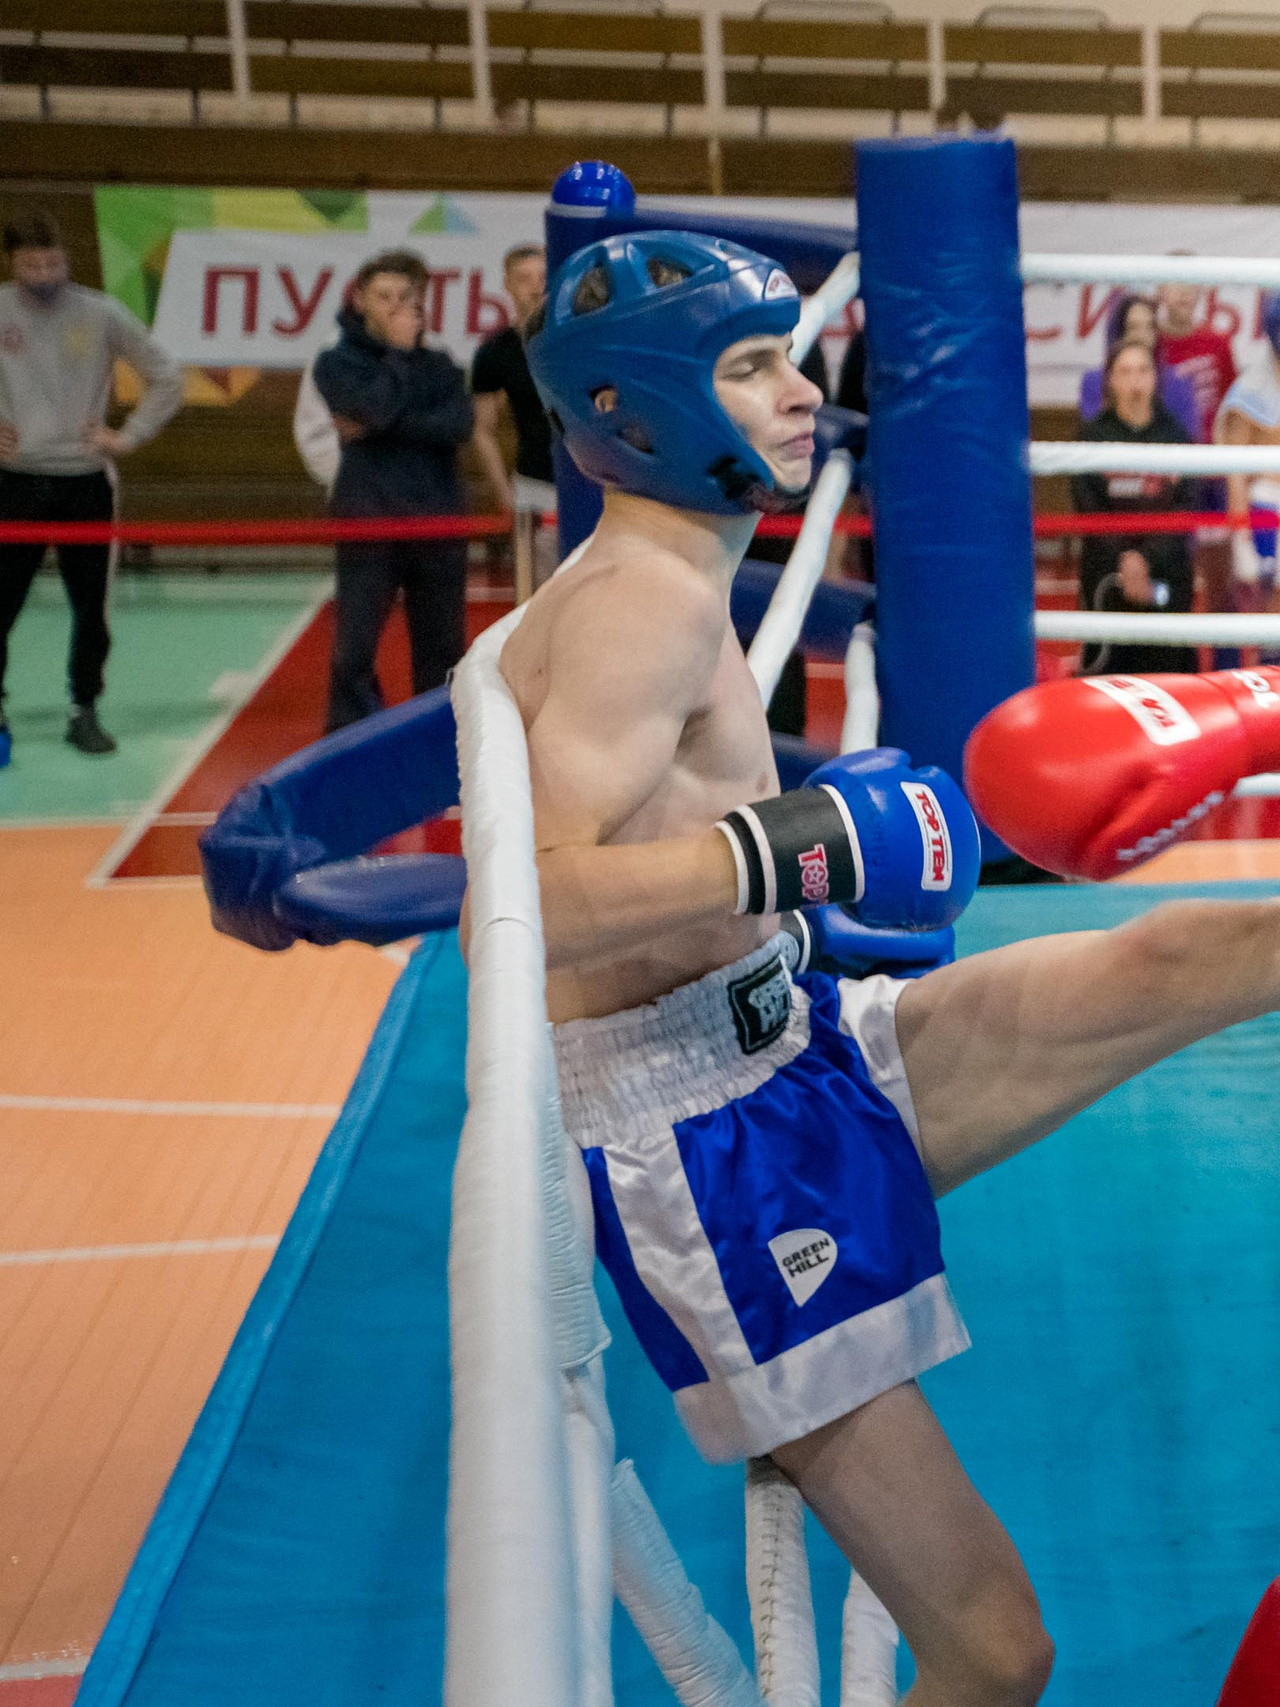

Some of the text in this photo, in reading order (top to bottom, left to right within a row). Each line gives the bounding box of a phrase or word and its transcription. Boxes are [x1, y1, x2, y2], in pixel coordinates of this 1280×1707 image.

[202, 264, 515, 338] ПУТЬ
[915, 792, 941, 833] TOP
[929, 836, 946, 882] TEN
[797, 843, 830, 904] TOP
[782, 1238, 830, 1267] GREEN
[789, 1254, 829, 1278] HILL
